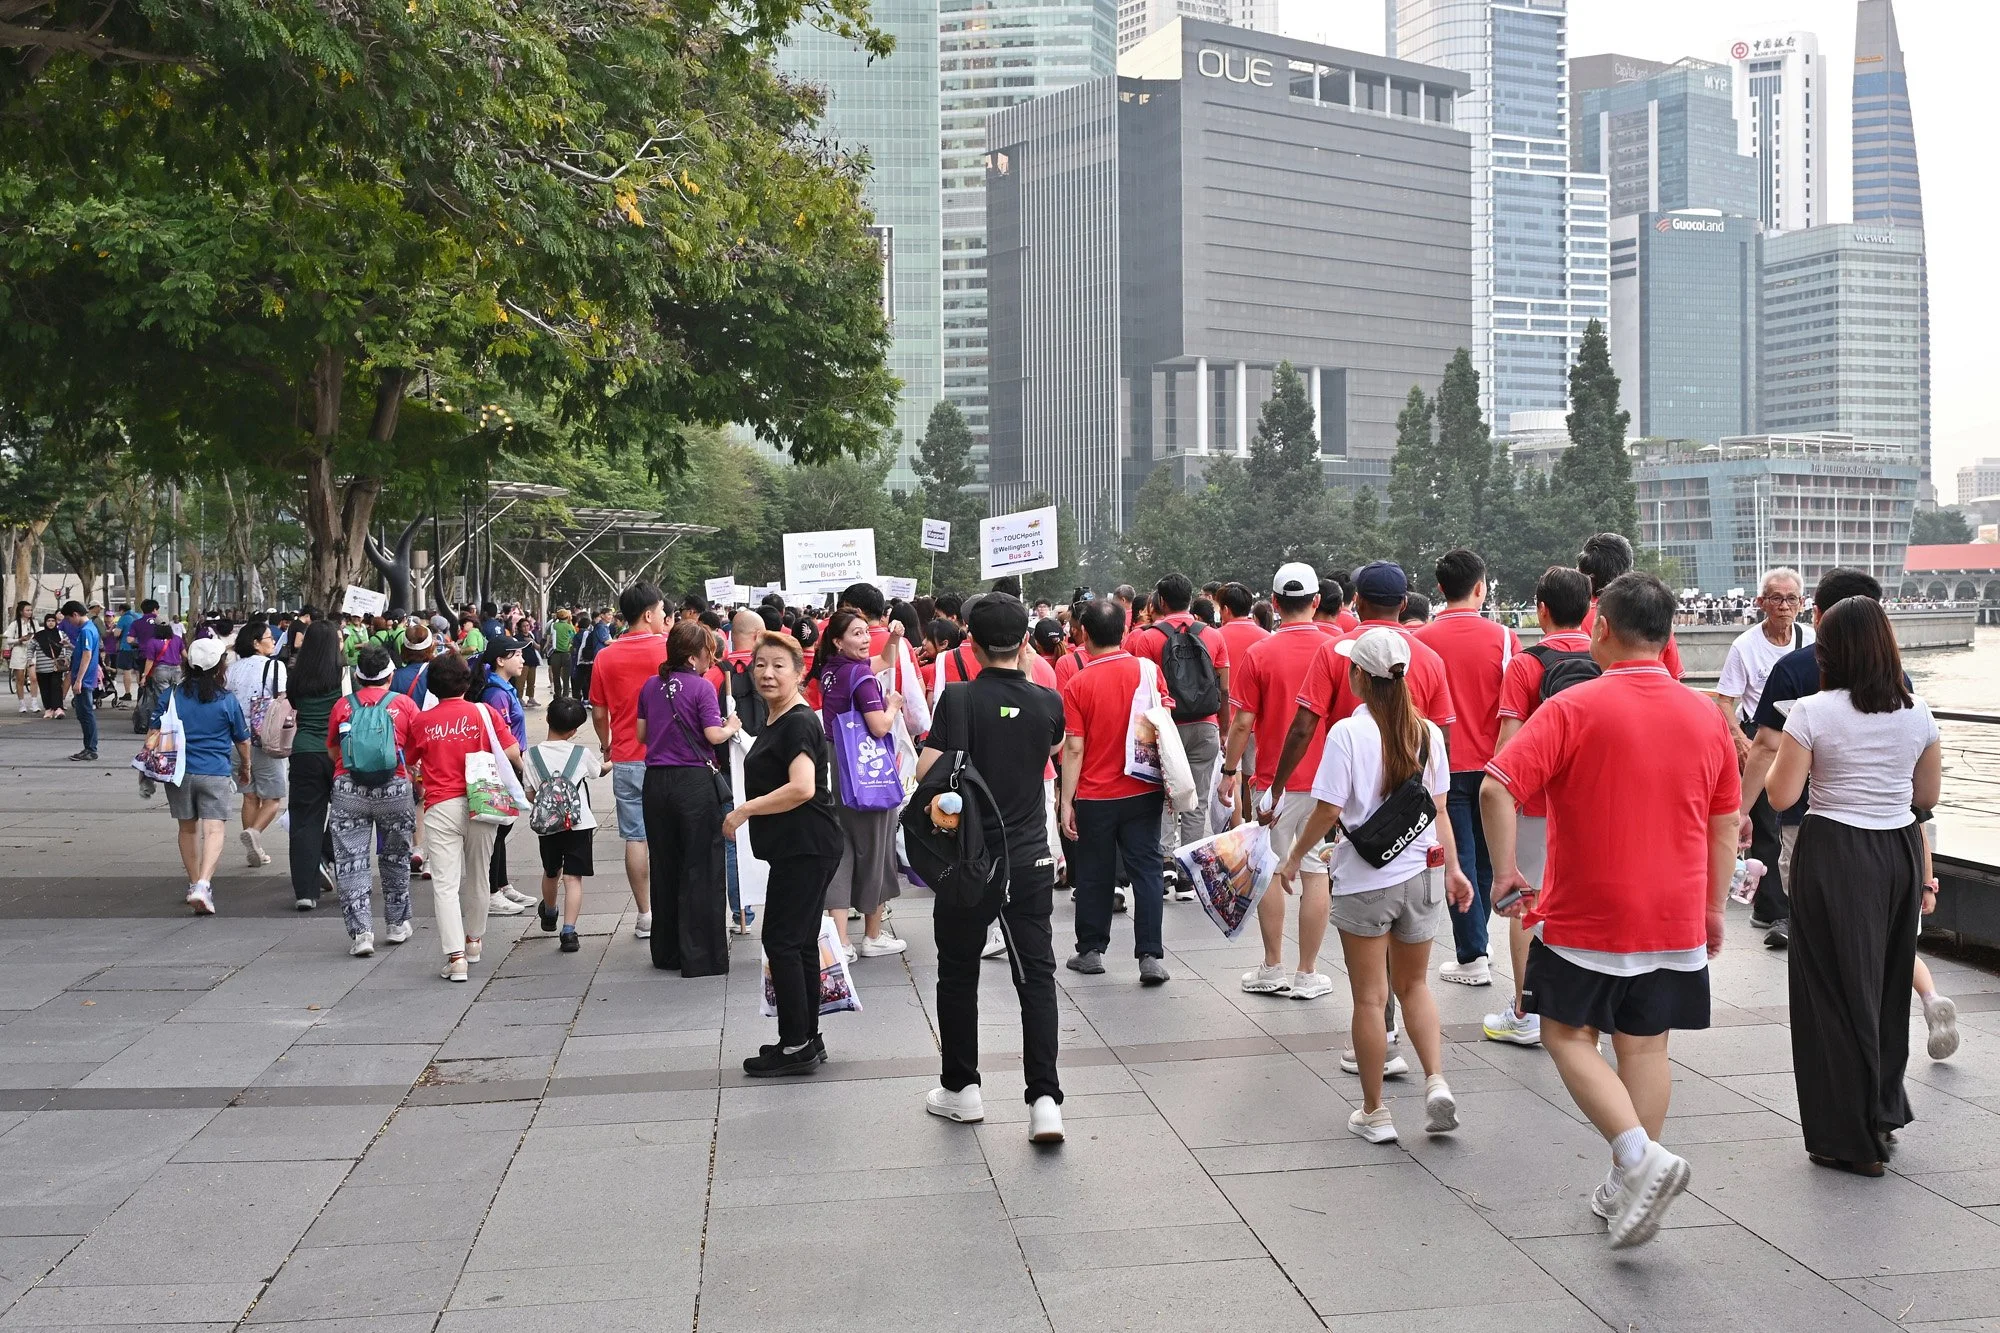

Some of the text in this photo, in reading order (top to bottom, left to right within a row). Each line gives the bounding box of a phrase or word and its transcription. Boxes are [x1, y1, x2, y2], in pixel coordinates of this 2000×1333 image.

[1198, 48, 1273, 87] OUE
[1704, 75, 1727, 91] MYP
[1855, 231, 1896, 244] wework
[1003, 530, 1041, 542] TOUCHpoint
[993, 539, 1044, 554] @Wellington 513
[813, 551, 858, 559] TOUCHpoint
[1023, 550, 1032, 558] 28
[801, 559, 861, 571] @Wellington 513
[1381, 811, 1429, 861] adidas
